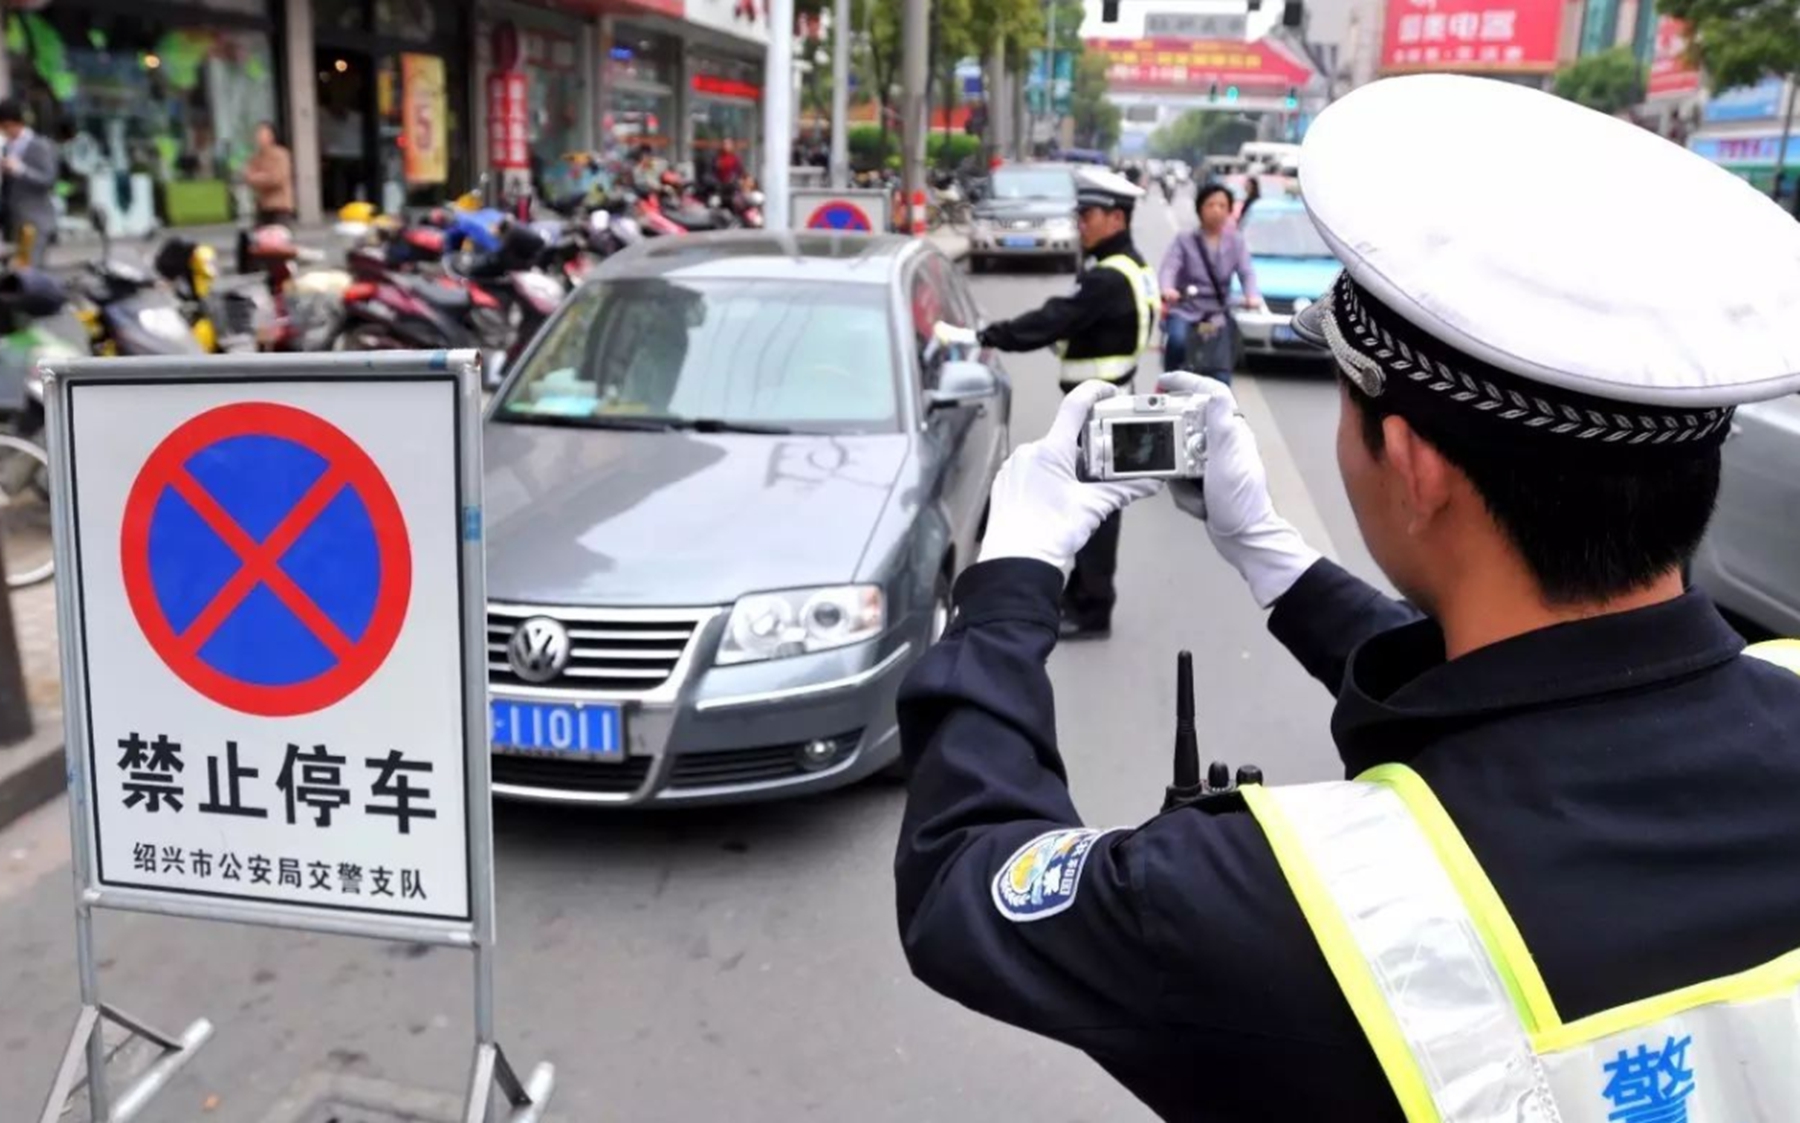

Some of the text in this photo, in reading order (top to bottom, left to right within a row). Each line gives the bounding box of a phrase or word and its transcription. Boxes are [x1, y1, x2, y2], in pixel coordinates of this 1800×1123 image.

[117, 732, 437, 834] 禁止停车
[132, 842, 427, 900] 绍兴市公安局交警支队
[1602, 1035, 1695, 1123] 警
